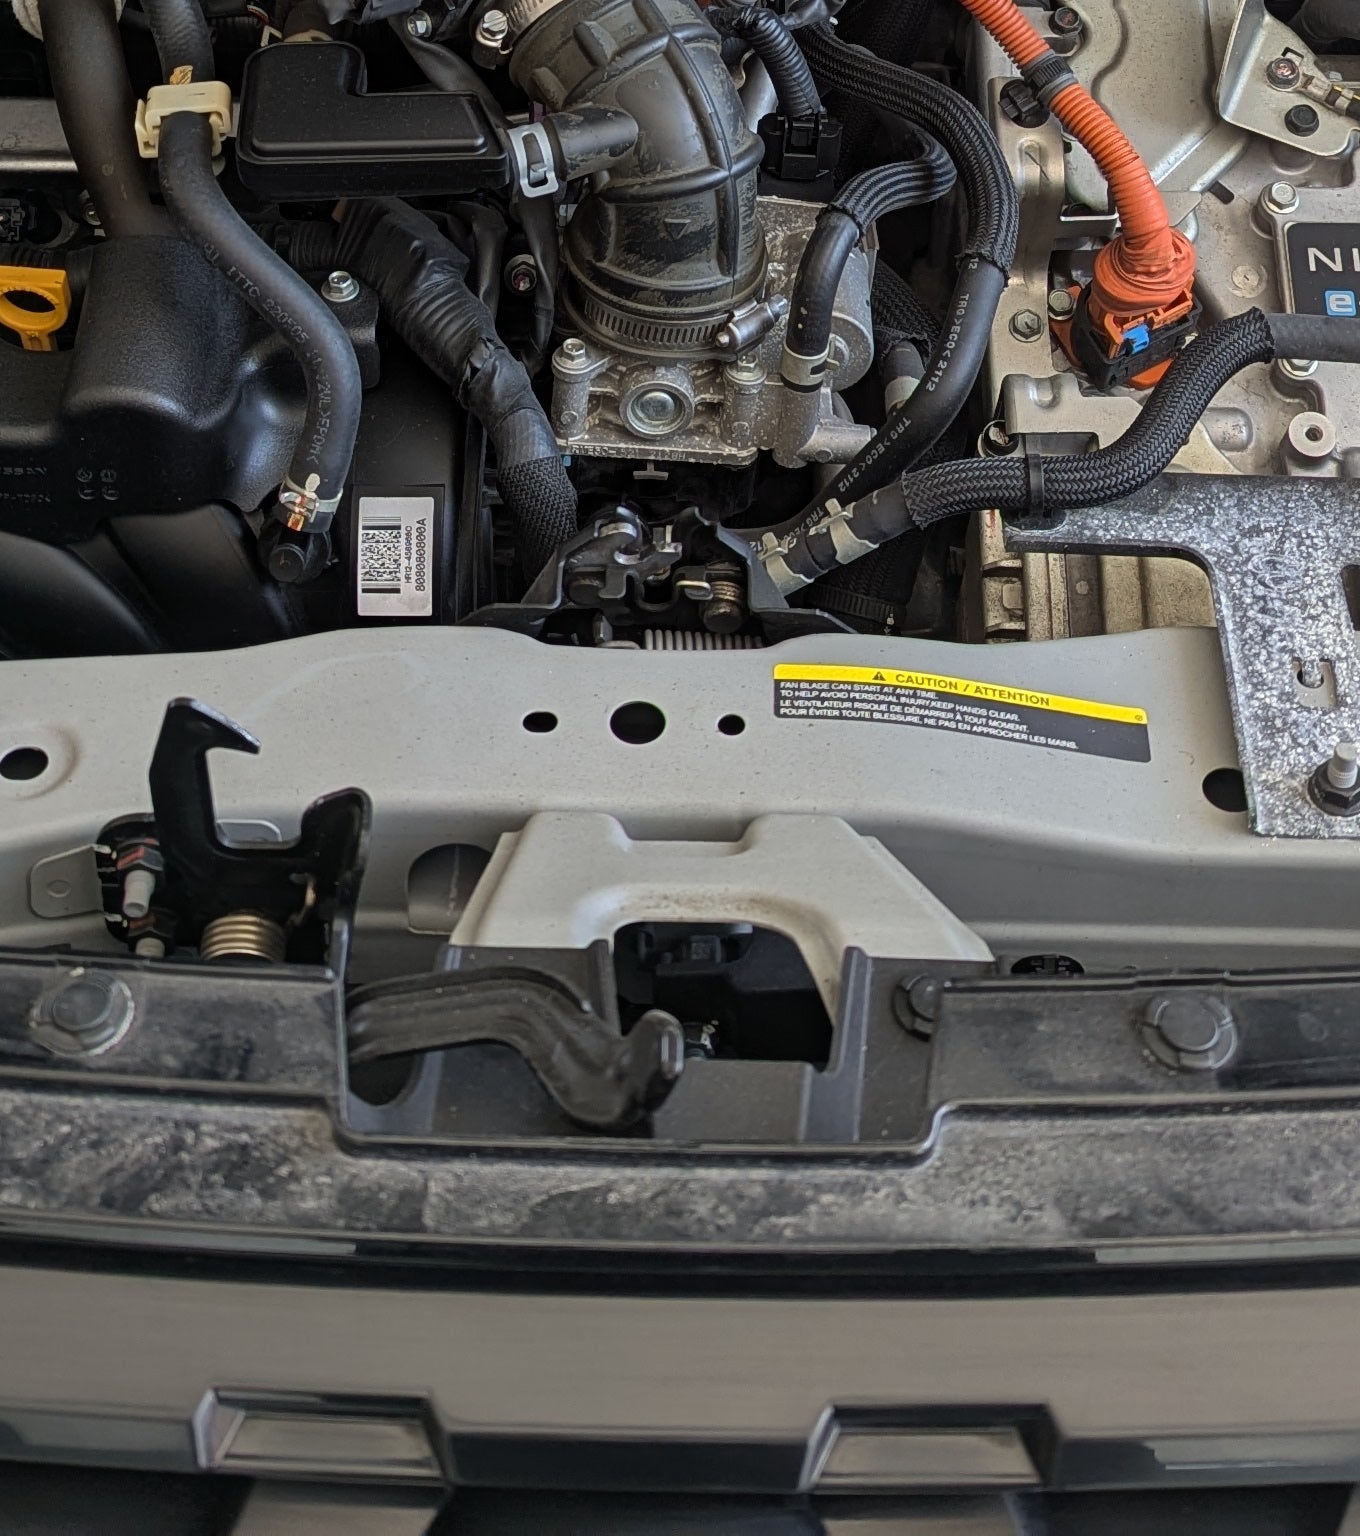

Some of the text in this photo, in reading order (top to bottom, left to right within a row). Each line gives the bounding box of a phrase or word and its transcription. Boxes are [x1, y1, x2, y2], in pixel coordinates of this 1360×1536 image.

[780, 681, 798, 689] FAN
[800, 682, 830, 690] BLADE
[831, 683, 852, 691] CAN
[853, 684, 881, 693] START
[882, 686, 894, 694] AT
[895, 687, 915, 696] ANY
[780, 689, 793, 698] TO
[794, 690, 819, 698] HELP
[819, 691, 848, 700] AVOID
[849, 692, 898, 703] PERSONAL
[955, 705, 988, 716] HANDS
[989, 709, 1020, 721] CLEAR.
[895, 673, 958, 691] CAUTION
[974, 685, 1050, 707] ATTENTION
[780, 699, 791, 707] LE
[793, 700, 852, 709] VENTILATEUR
[853, 702, 888, 712] RISQUE
[890, 704, 903, 713] DE
[963, 714, 987, 725] TOUT
[988, 718, 1030, 733] MOMENT.
[780, 707, 807, 715] POUR
[841, 710, 871, 719] TOUTE
[924, 717, 937, 726] NE
[938, 719, 957, 729] PAS
[958, 723, 971, 731] EN
[972, 725, 1028, 741] APPROCHER
[1028, 735, 1047, 745] LES
